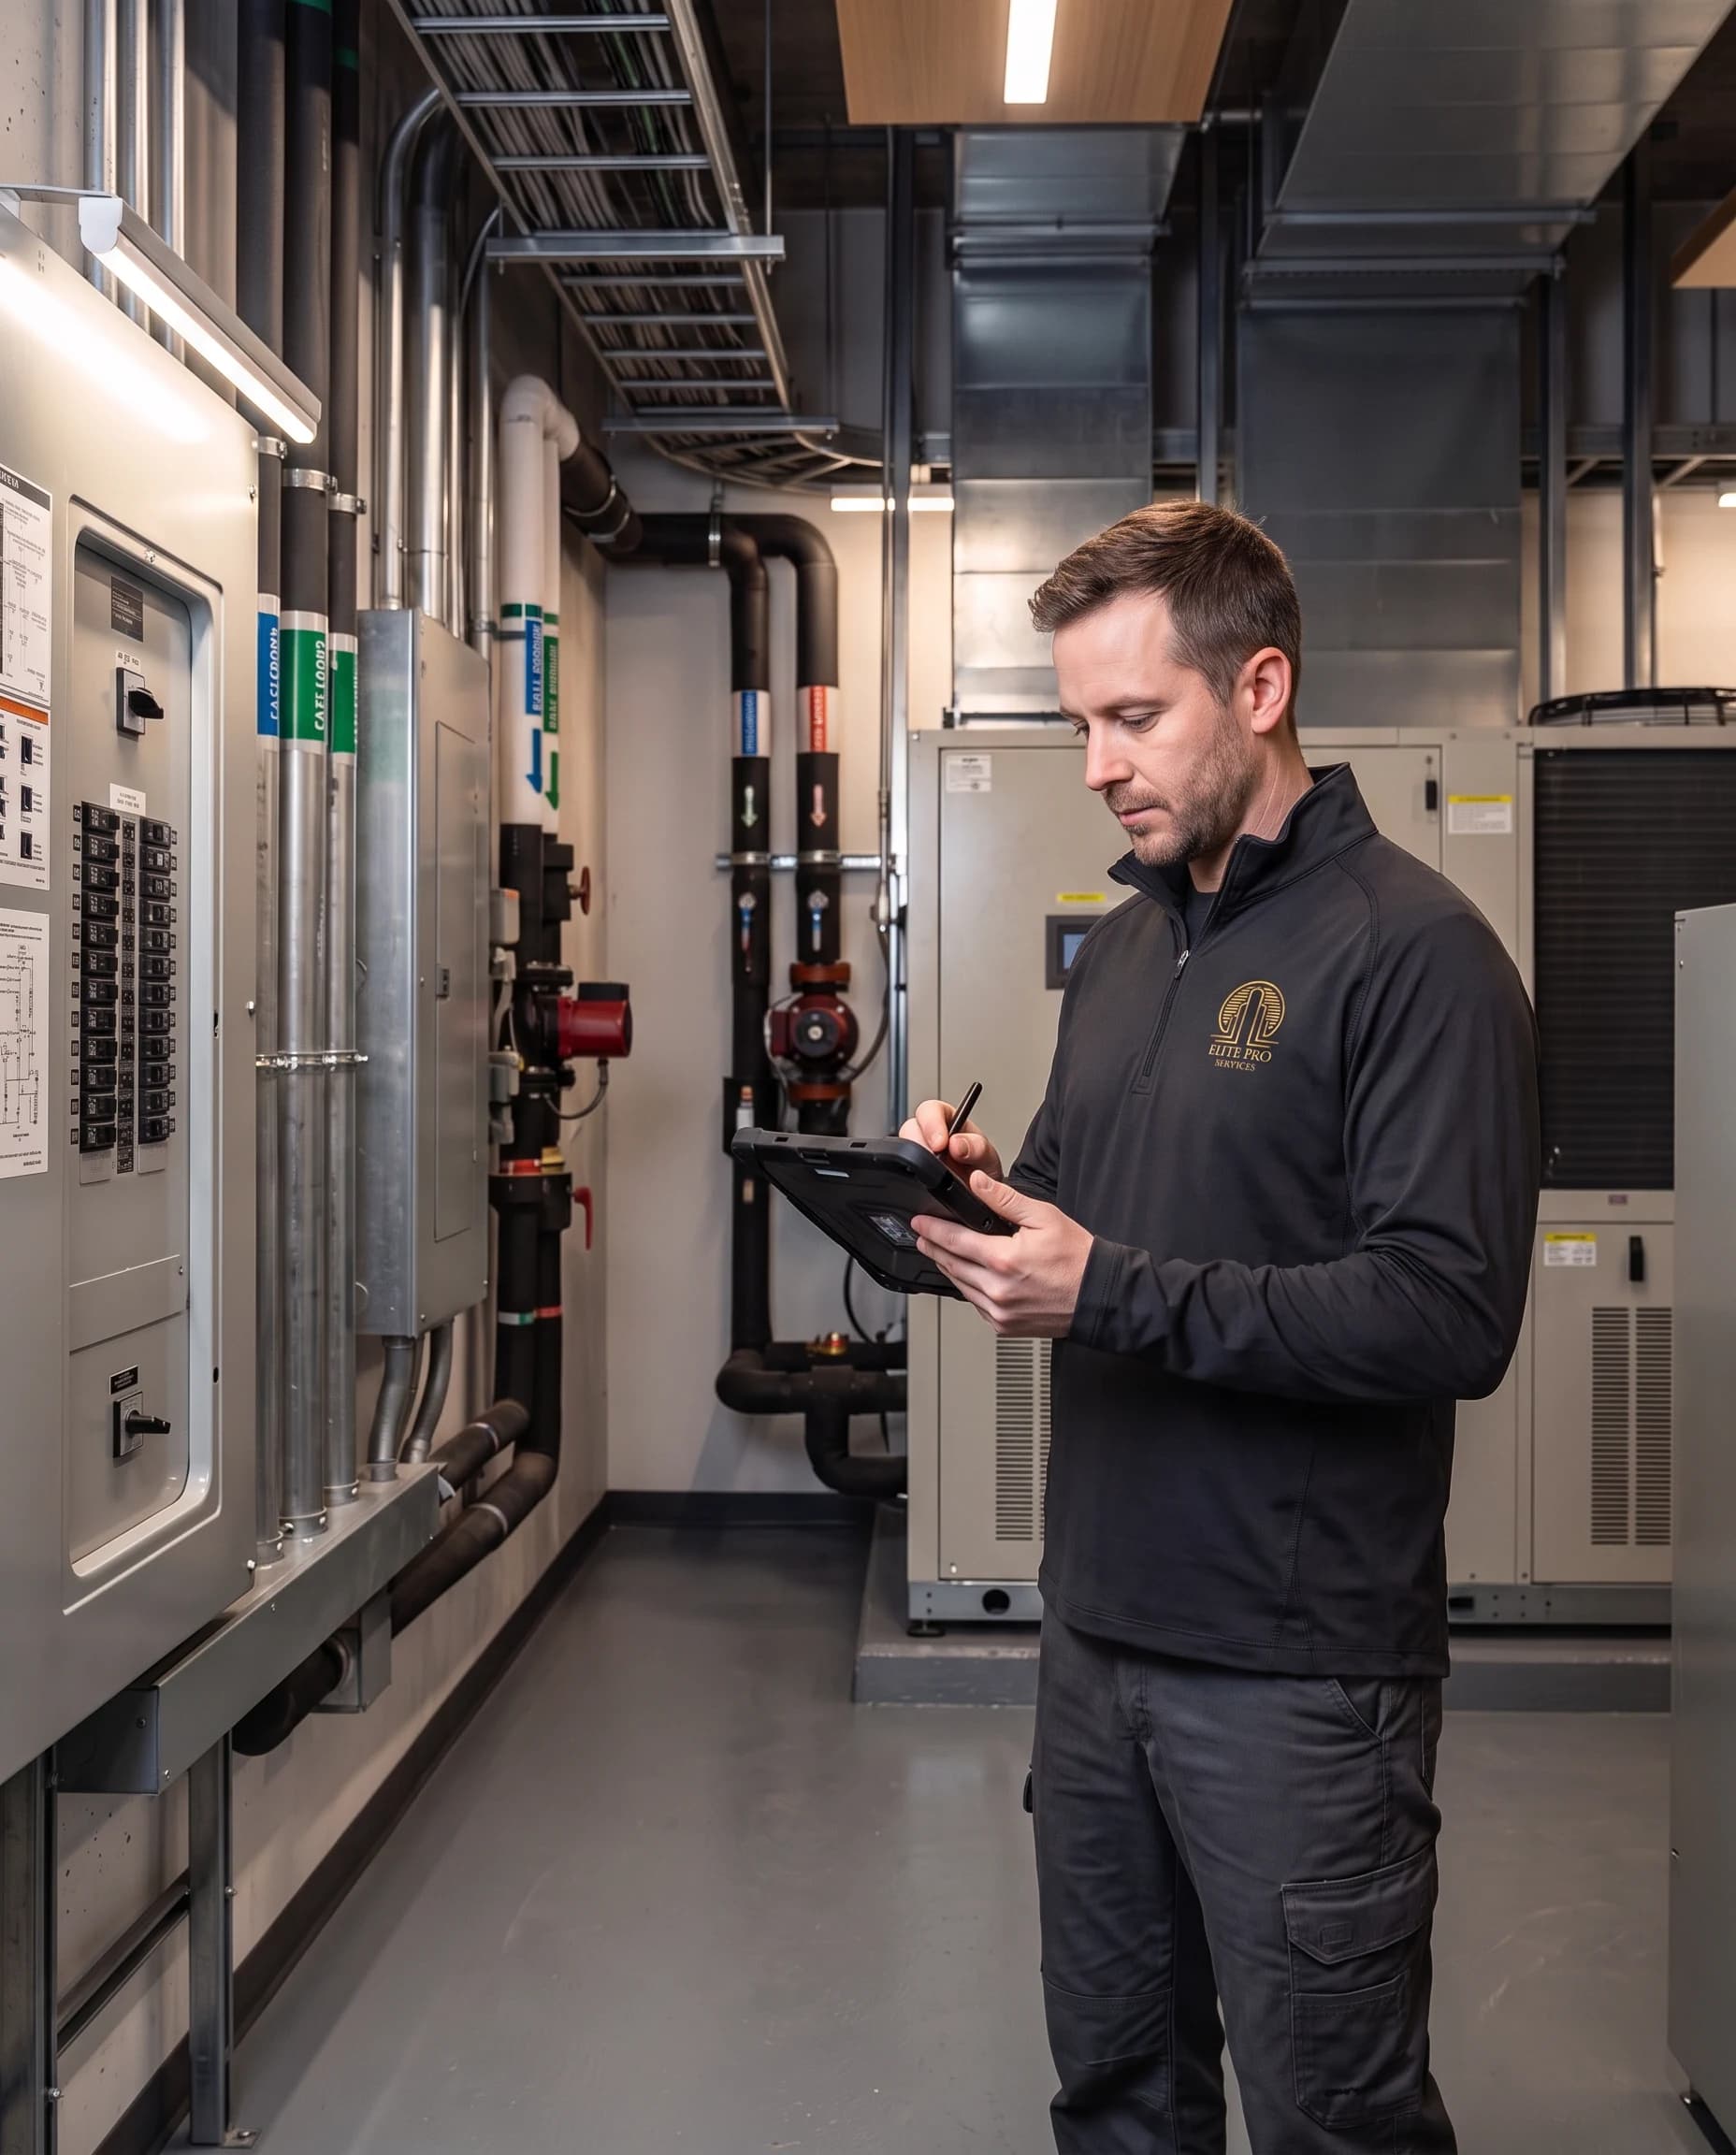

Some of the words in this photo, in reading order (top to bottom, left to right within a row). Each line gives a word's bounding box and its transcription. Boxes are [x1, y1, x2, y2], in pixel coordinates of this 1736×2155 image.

[1208, 1044, 1242, 1059] ELITE
[1243, 1048, 1272, 1063] PRO
[1214, 1059, 1256, 1072] SERVICES
